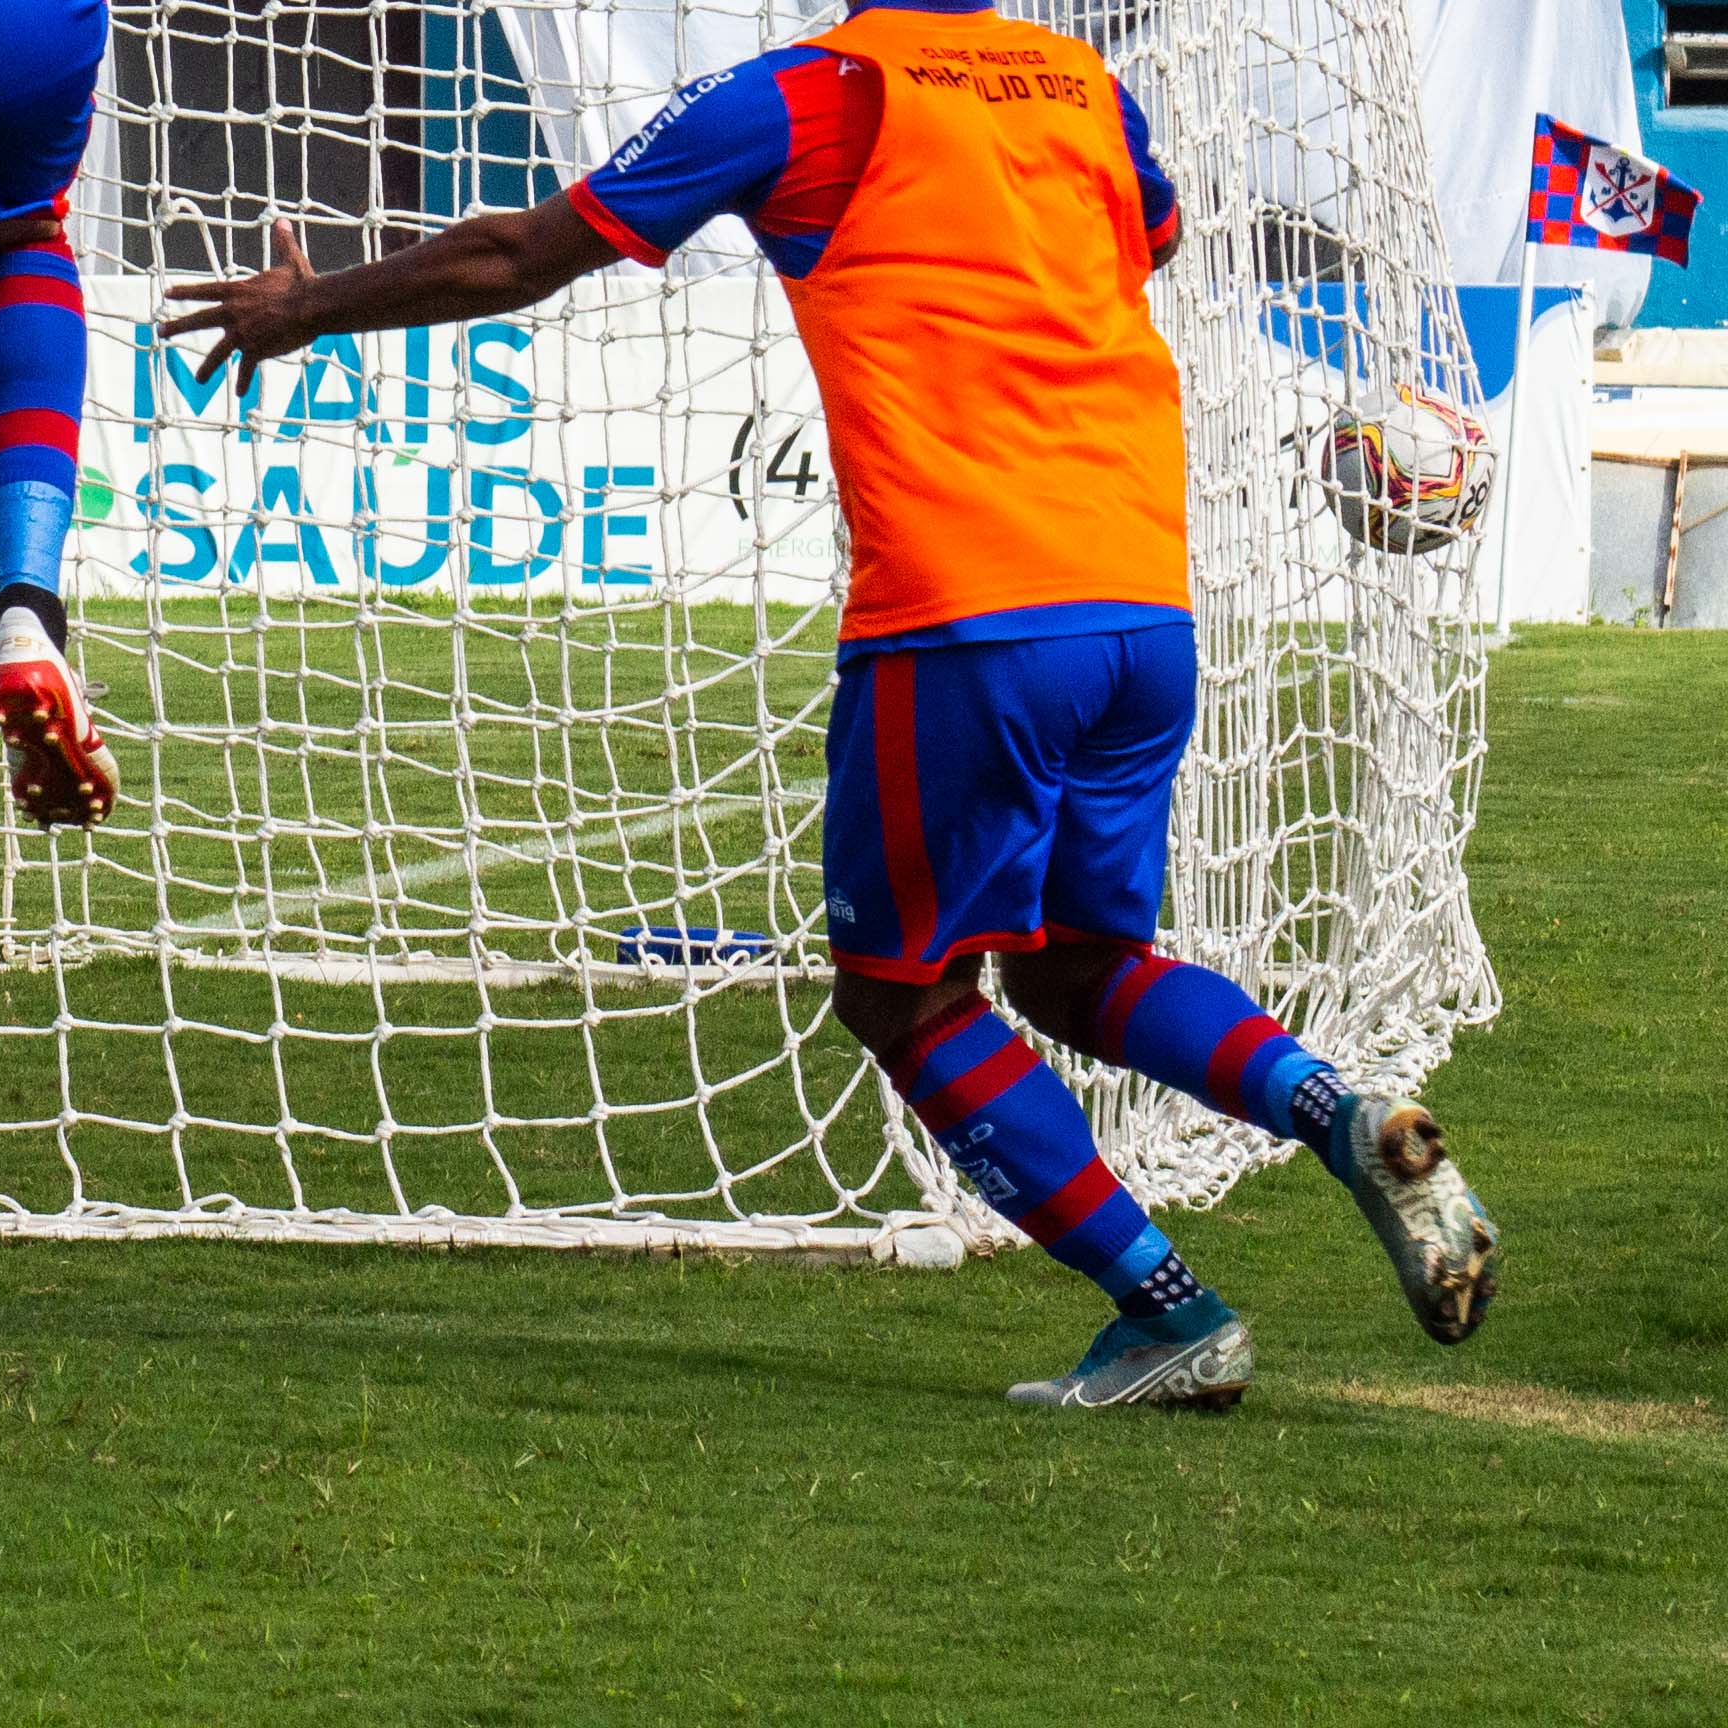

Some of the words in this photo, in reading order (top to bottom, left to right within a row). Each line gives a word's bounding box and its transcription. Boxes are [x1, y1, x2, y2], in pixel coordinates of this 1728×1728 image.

[1037, 73, 1089, 110] DIAS
[134, 319, 534, 445] MAIS
[132, 444, 655, 586] SAÚDE
